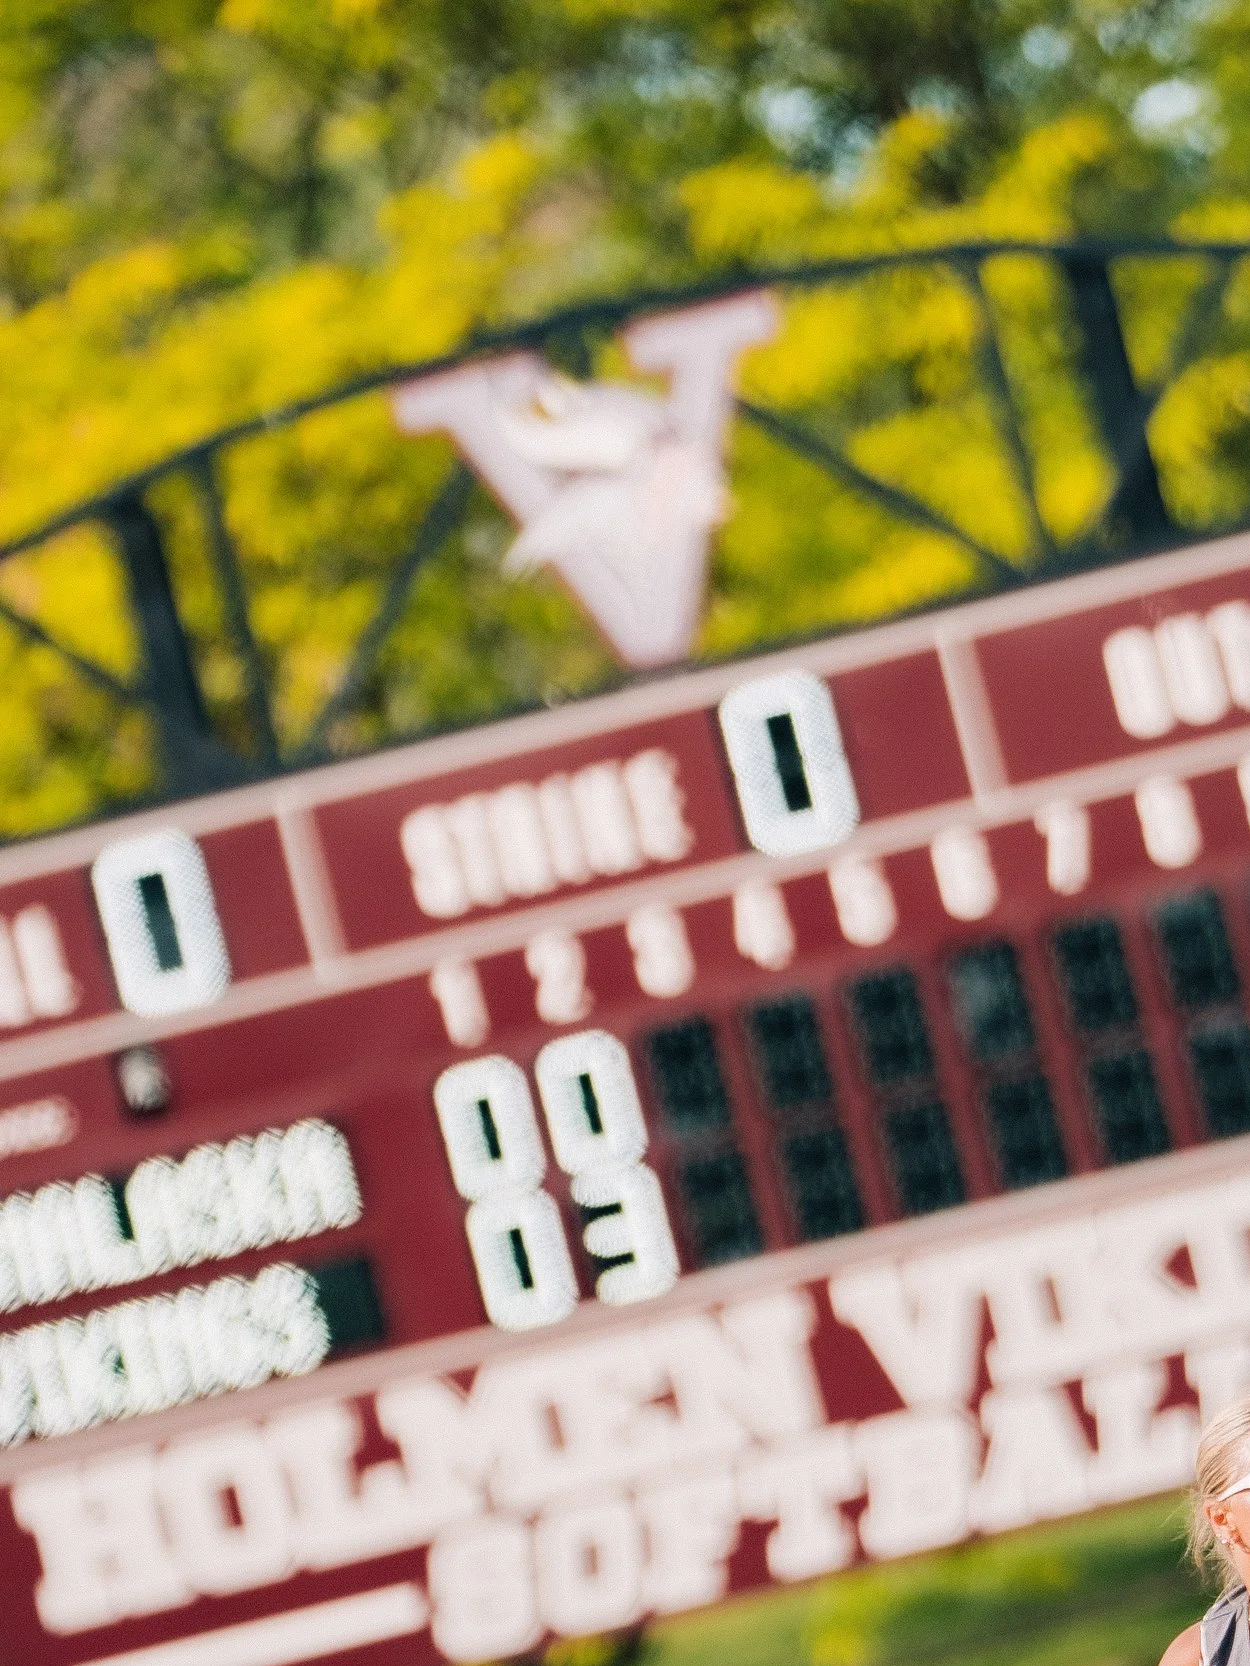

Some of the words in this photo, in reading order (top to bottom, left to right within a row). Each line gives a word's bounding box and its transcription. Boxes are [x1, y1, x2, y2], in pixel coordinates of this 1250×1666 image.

[400, 748, 697, 920] STRIKE
[717, 668, 861, 857] 0
[93, 828, 231, 1018] 0
[433, 1055, 546, 1200] 0
[534, 1030, 649, 1175] 0
[466, 1190, 578, 1332] 0
[570, 1163, 681, 1306] 3
[10, 1283, 822, 1636] HOLMEN
